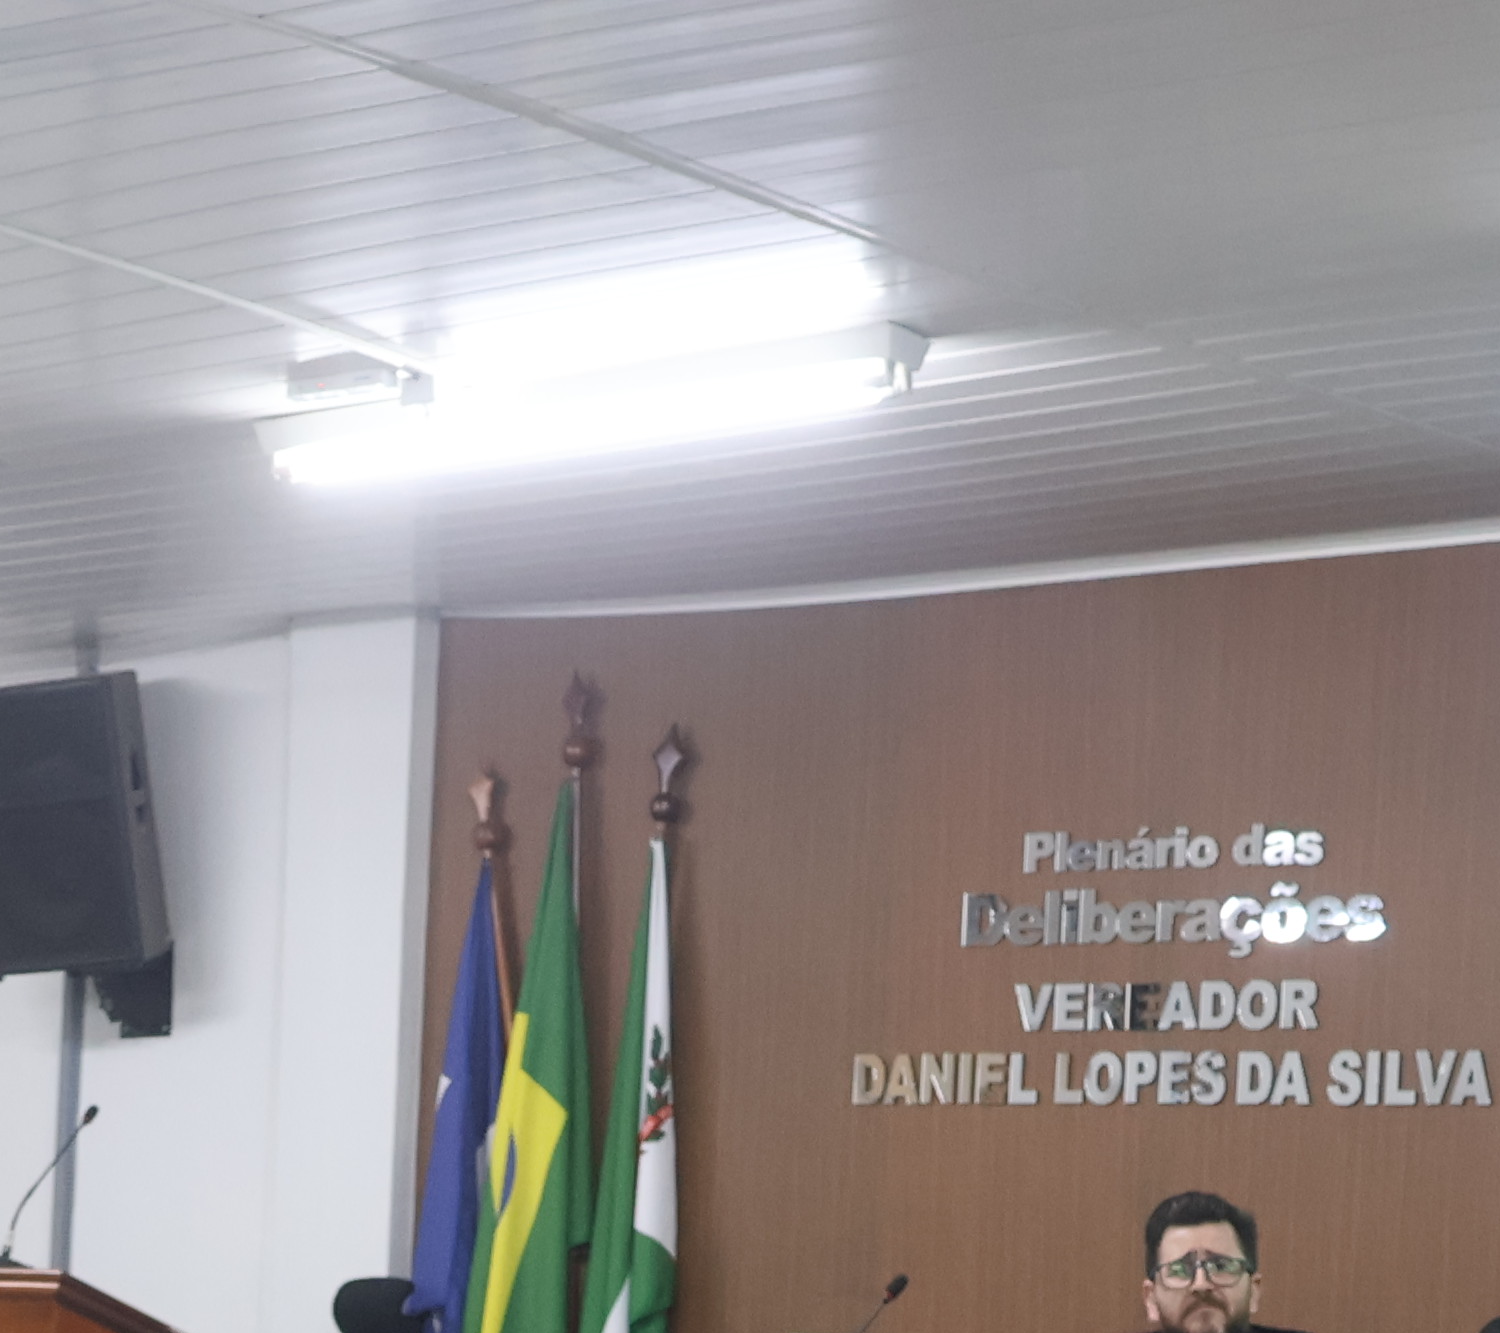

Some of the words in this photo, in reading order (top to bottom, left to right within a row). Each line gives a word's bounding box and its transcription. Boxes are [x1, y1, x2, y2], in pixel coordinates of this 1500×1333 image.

[1023, 826, 1219, 873] Plenário
[1232, 823, 1324, 866] das
[961, 881, 1387, 958] Deliberações
[1014, 979, 1319, 1032] VEREADOR
[852, 1052, 1038, 1106] DANIEL
[1053, 1051, 1227, 1106] LOPES
[1236, 1051, 1310, 1105] DA
[1327, 1049, 1492, 1107] SILVA
